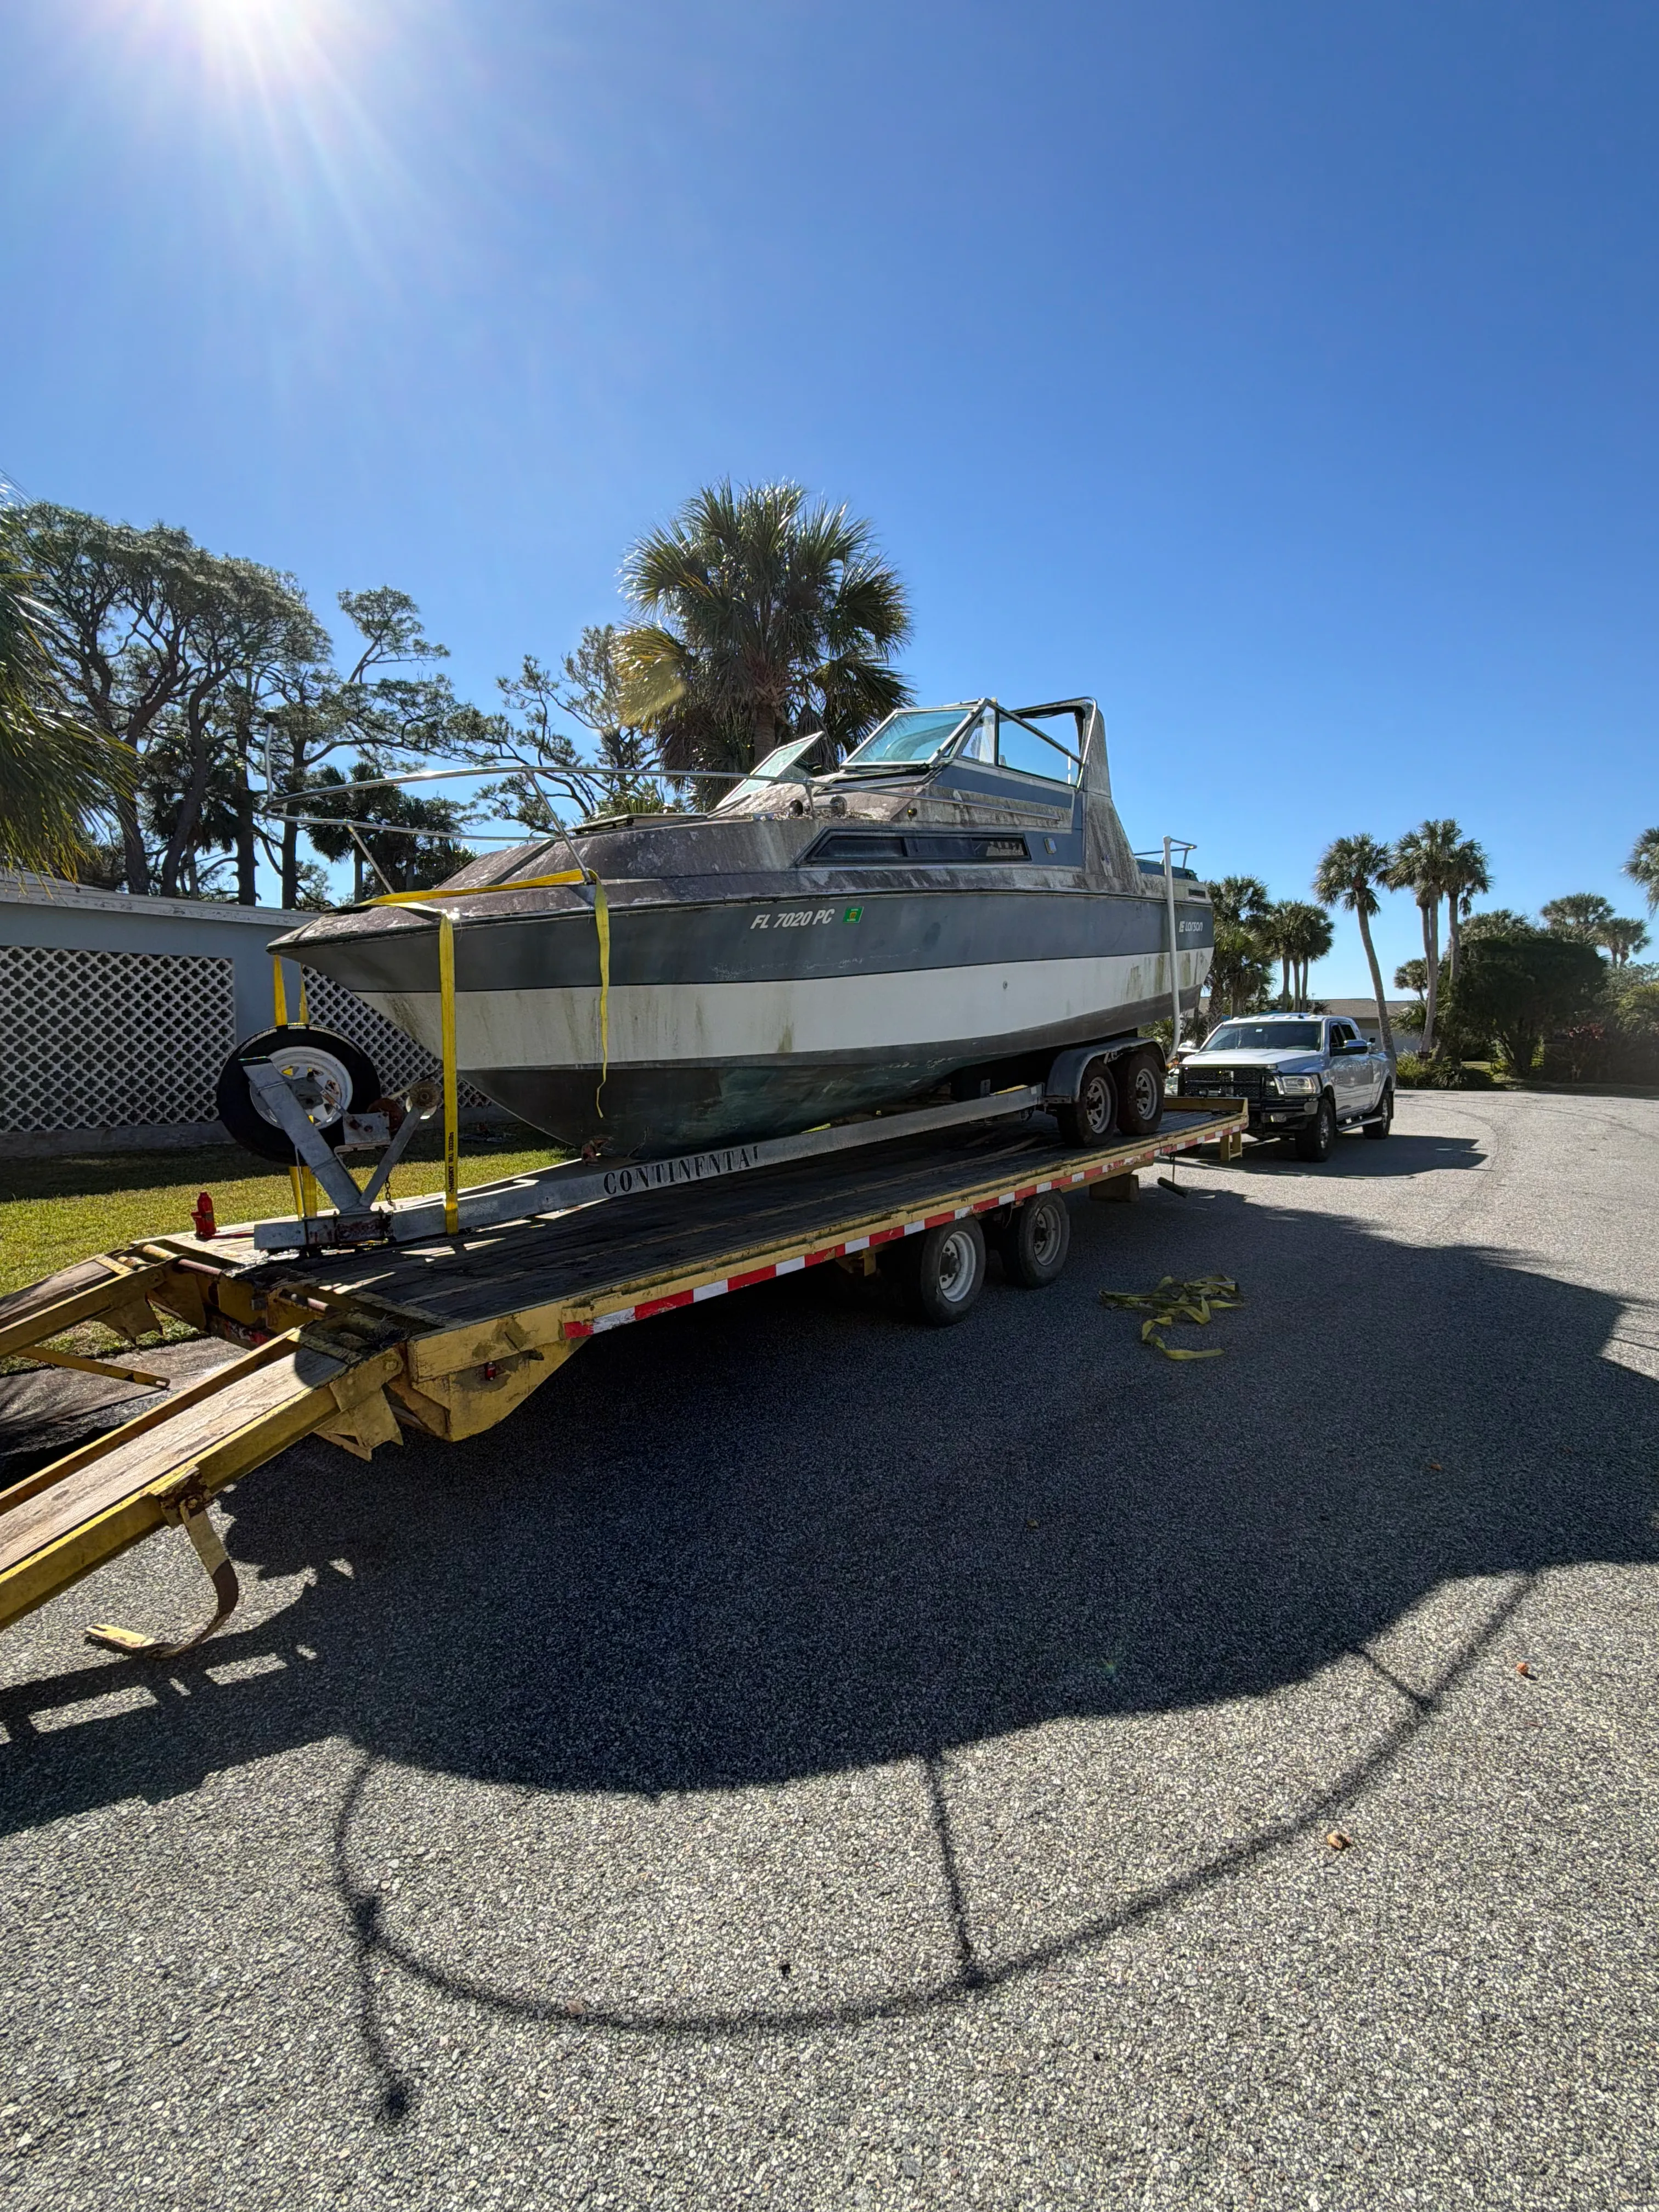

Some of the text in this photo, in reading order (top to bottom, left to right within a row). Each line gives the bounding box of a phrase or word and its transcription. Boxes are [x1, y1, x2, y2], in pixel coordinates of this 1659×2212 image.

[750, 909, 835, 929] FL 7020 PC
